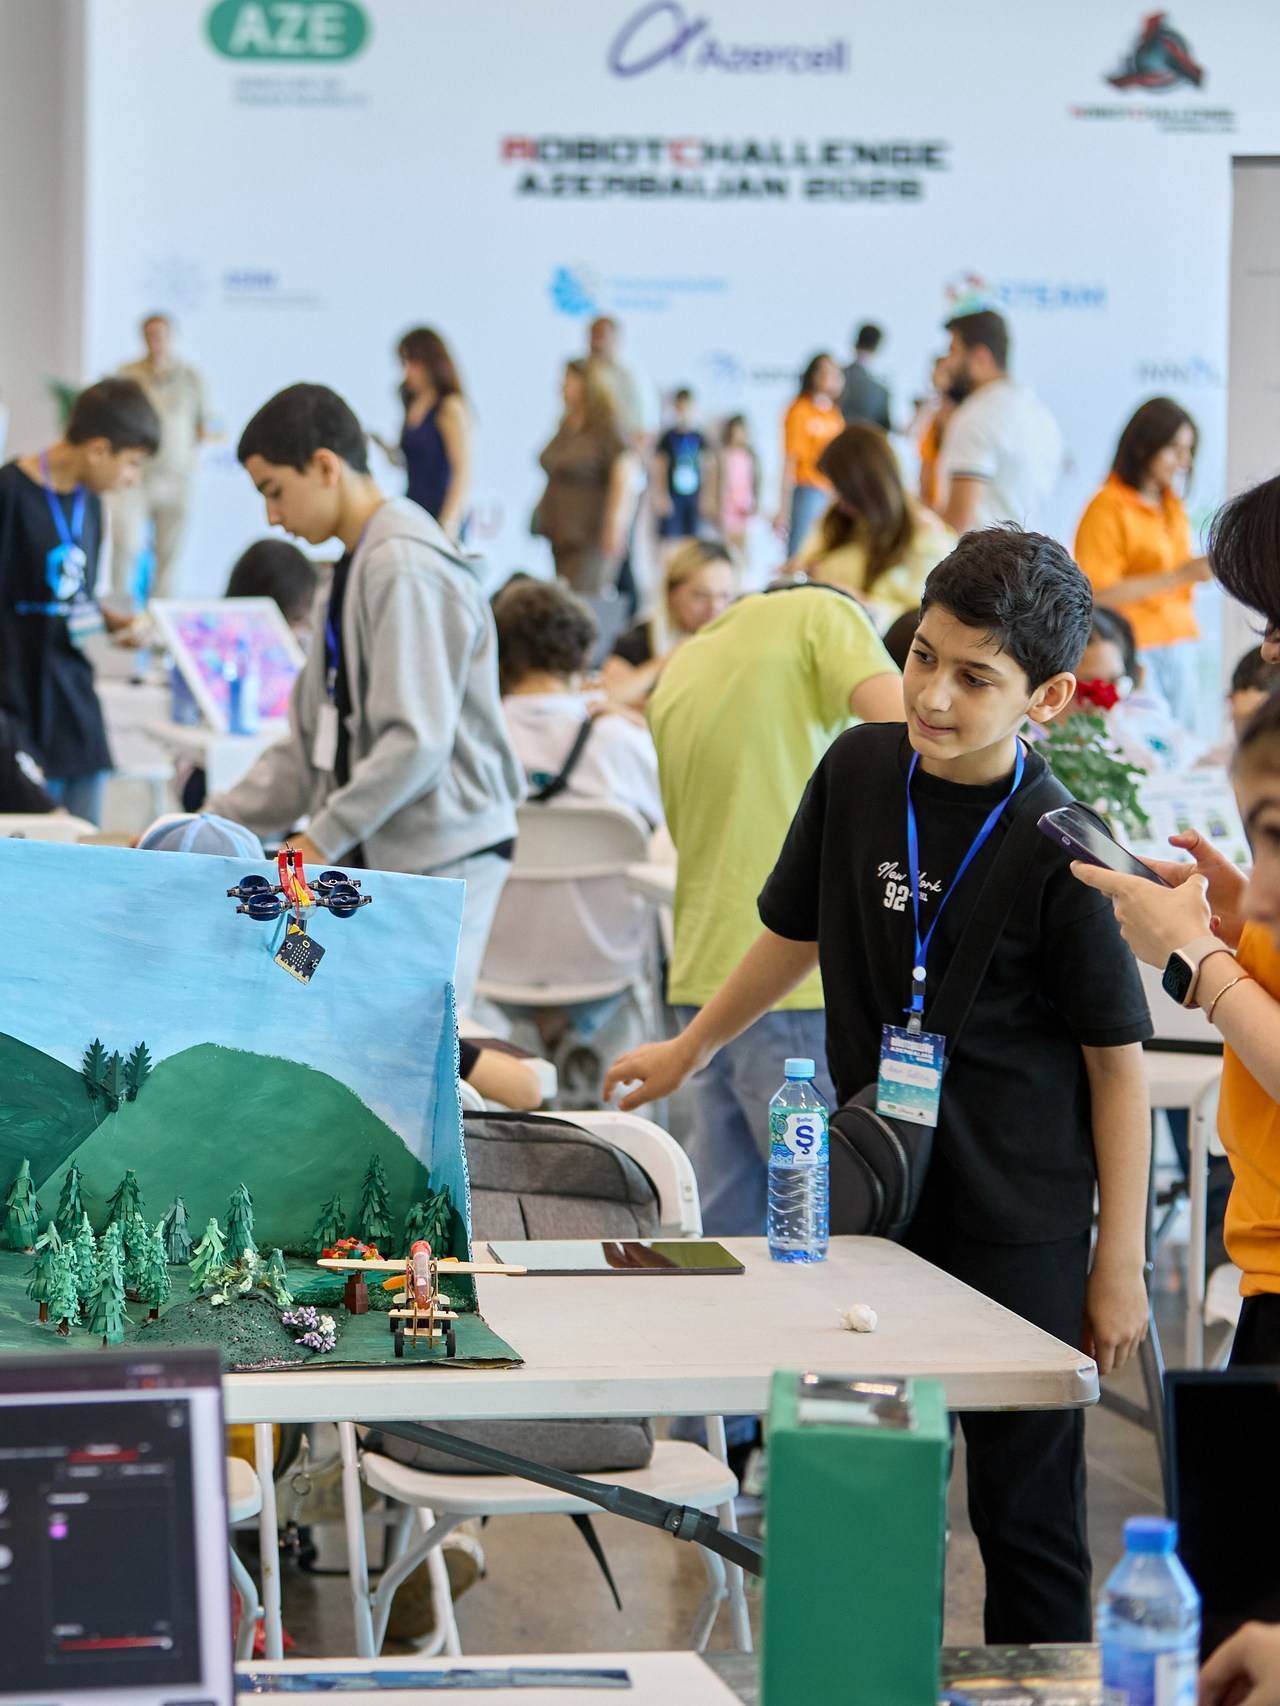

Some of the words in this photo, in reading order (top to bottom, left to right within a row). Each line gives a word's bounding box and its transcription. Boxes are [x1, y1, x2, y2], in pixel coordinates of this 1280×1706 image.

[227, 2, 347, 55] AZE
[696, 38, 851, 75] Azercell
[501, 136, 949, 169] ROBOTCHALLENGE
[517, 174, 790, 201] AZERBAIJAN
[877, 861, 907, 881] New
[883, 881, 910, 912] 92
[796, 1125, 815, 1155] Ş
